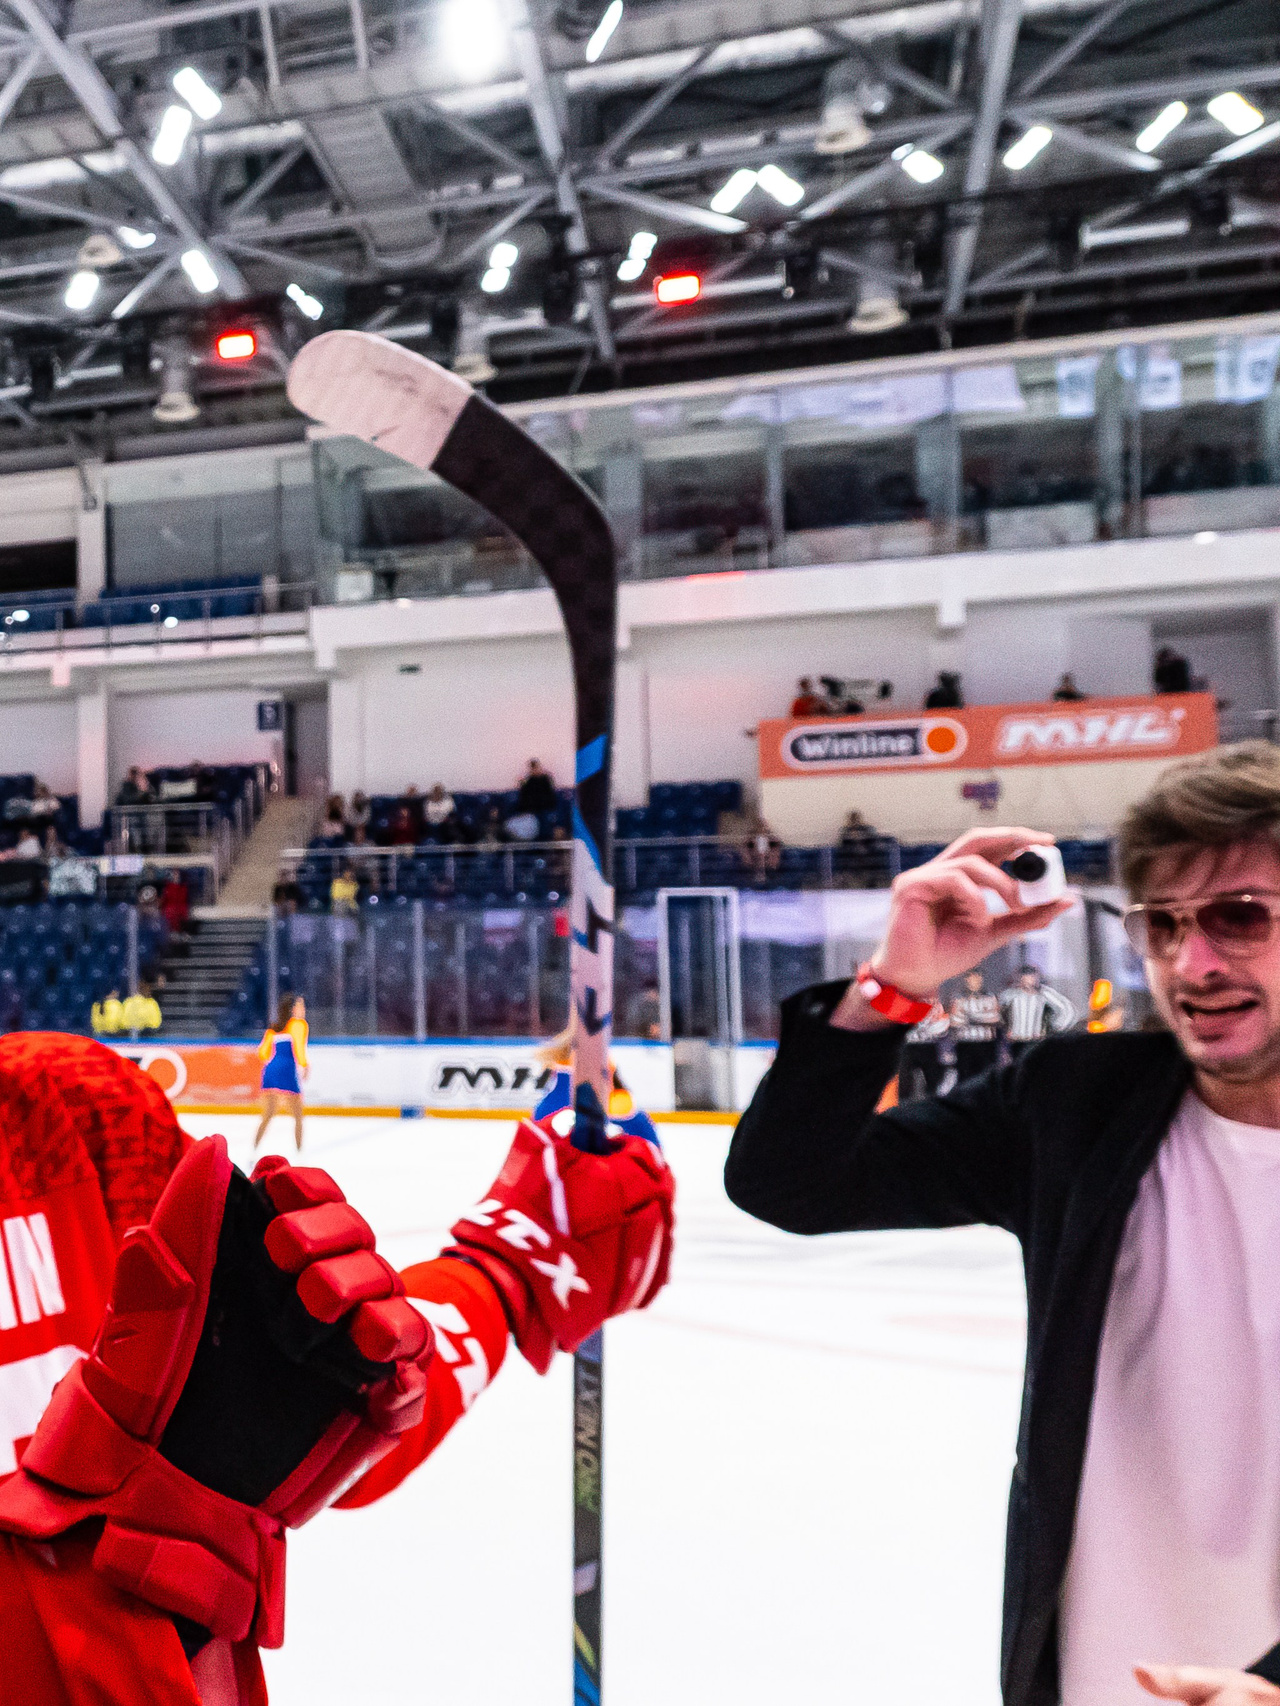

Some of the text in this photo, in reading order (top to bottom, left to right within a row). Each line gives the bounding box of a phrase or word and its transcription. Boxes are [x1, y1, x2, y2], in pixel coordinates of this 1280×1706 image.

[799, 732, 917, 758] Winline
[1001, 713, 1172, 751] MHL
[439, 1067, 553, 1089] MH
